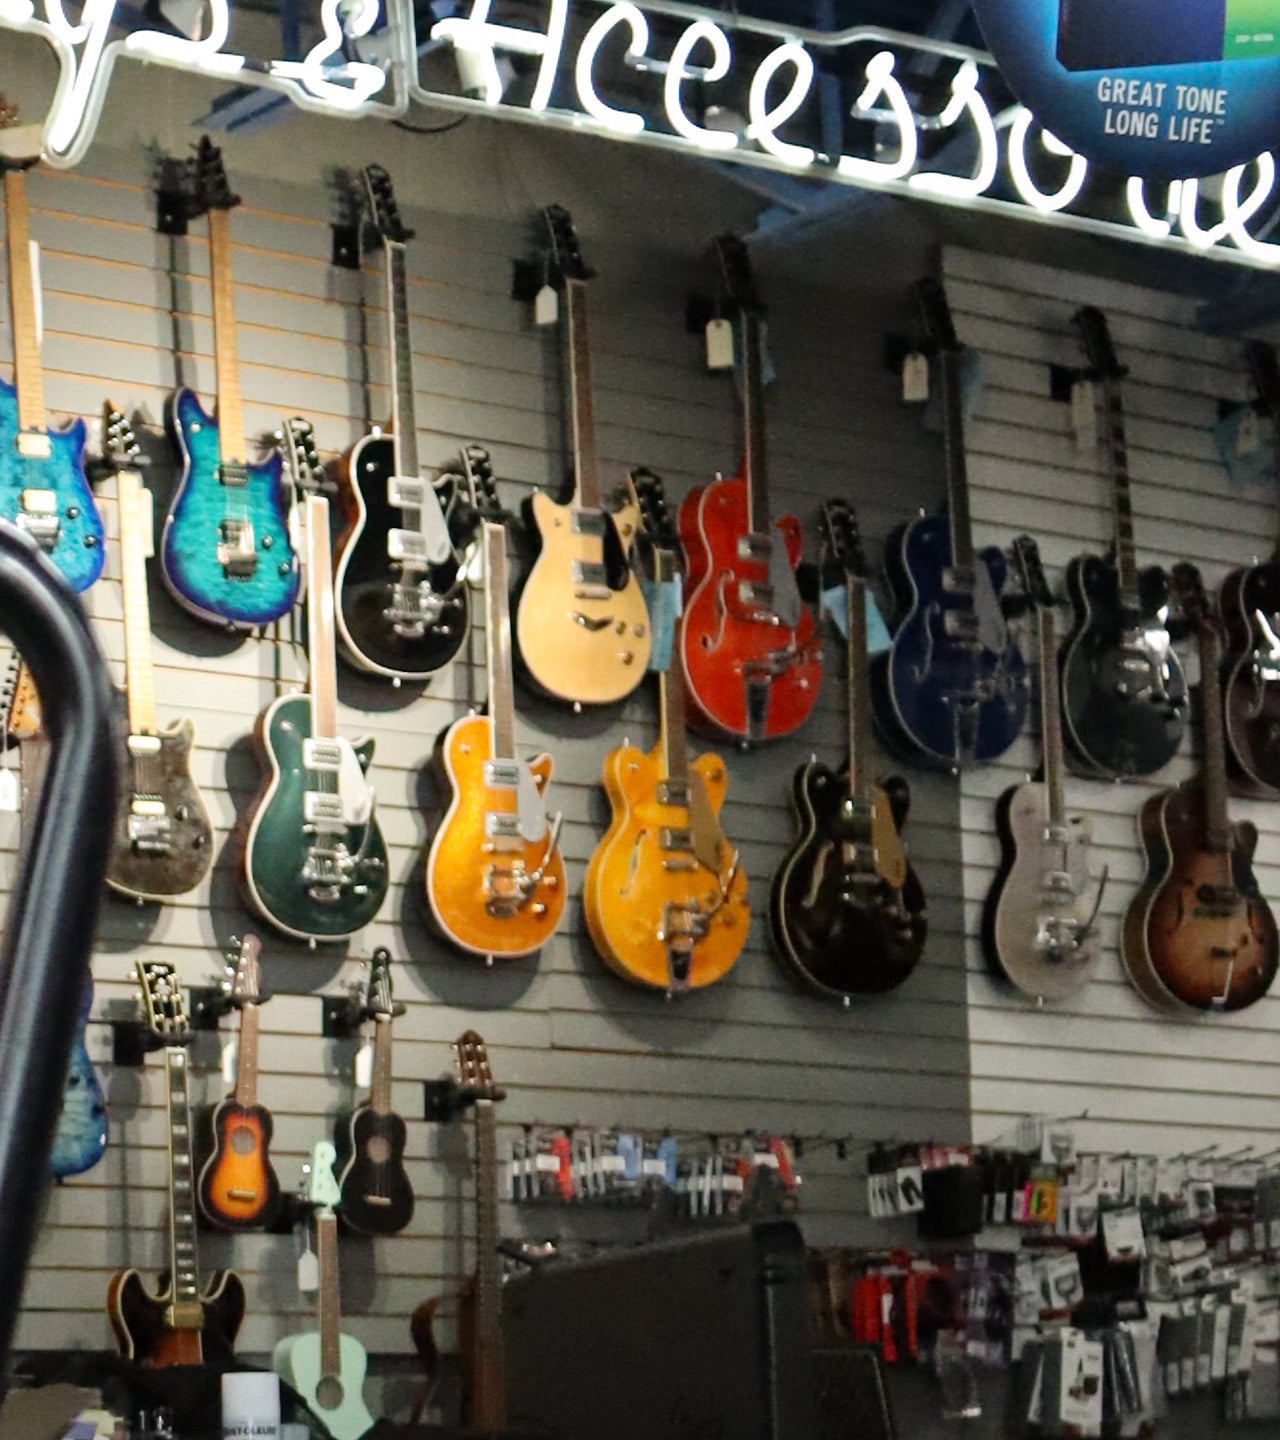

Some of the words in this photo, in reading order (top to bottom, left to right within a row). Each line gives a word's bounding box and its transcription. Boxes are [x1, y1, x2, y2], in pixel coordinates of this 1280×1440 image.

[1097, 76, 1167, 108] GREAT
[1176, 84, 1228, 115] TONE
[1104, 107, 1159, 138] LONG
